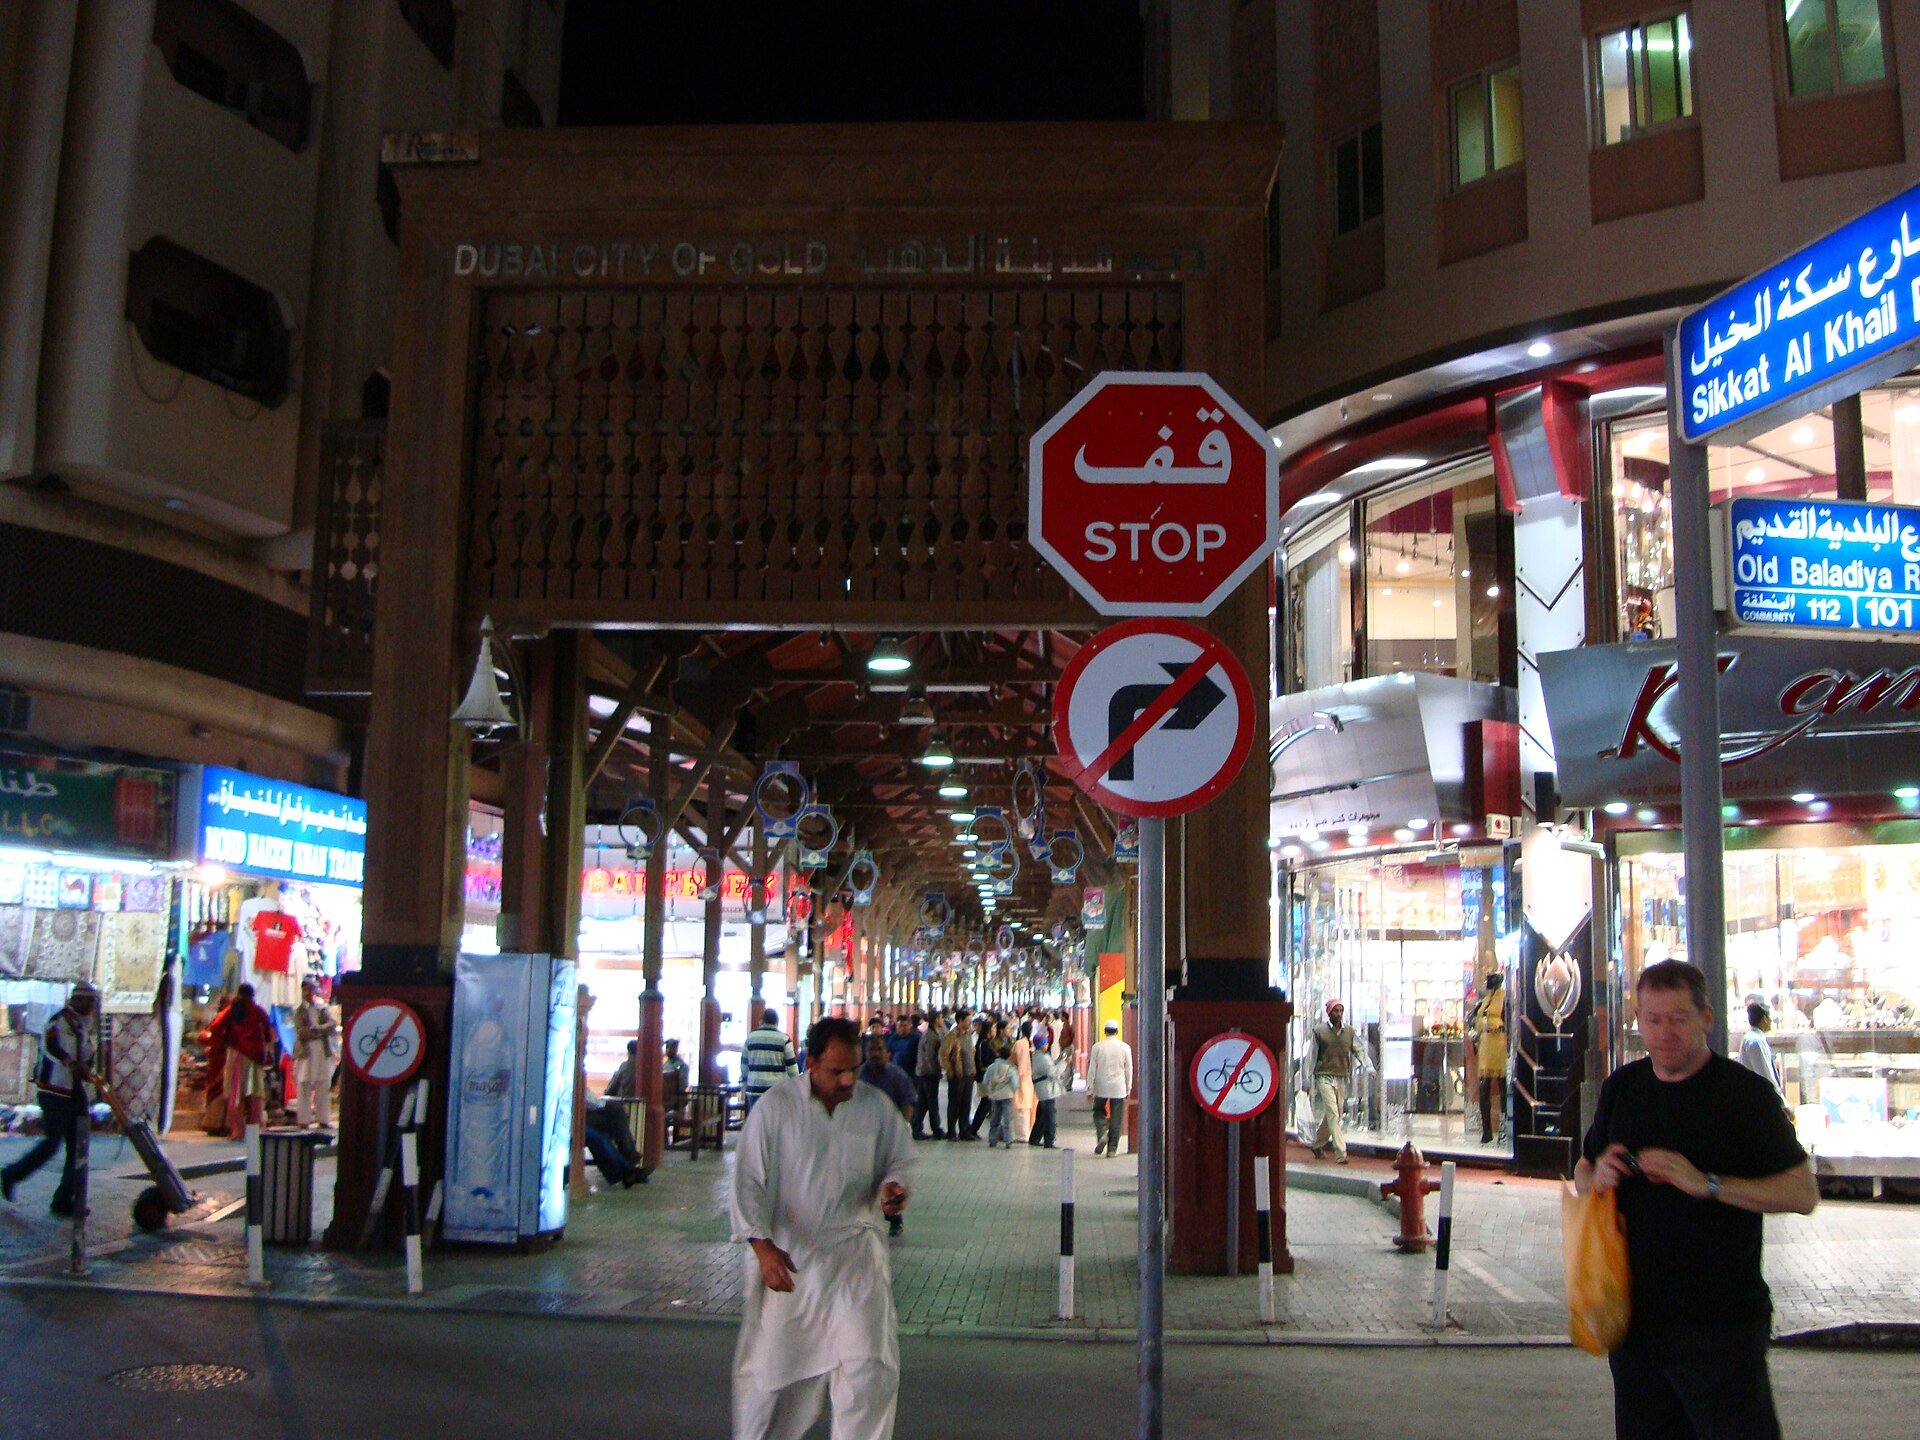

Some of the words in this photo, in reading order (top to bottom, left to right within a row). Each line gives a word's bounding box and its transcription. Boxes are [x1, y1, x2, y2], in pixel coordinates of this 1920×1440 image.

[453, 242, 557, 277] DUBAI
[573, 243, 660, 277] CITY
[671, 241, 716, 276] OF
[728, 241, 830, 276] GOLD
[995, 238, 1113, 282] مدينة
[1858, 211, 1920, 299] ارع
[1776, 262, 1852, 321] سكة
[1690, 285, 1772, 377] الخيل
[1692, 353, 1770, 425] Sikkat
[1784, 331, 1813, 383] Al
[1824, 289, 1898, 363] Khail
[1074, 406, 1232, 485] قف
[1084, 521, 1227, 563] STOP
[1736, 505, 1817, 552] القديم
[1816, 508, 1899, 553] البلدية
[1737, 553, 1778, 585] Old
[1790, 556, 1893, 594] Baladiya
[1742, 611, 1796, 623] COMMUNITY
[1806, 598, 1842, 622] 112
[1864, 597, 1914, 629] 101
